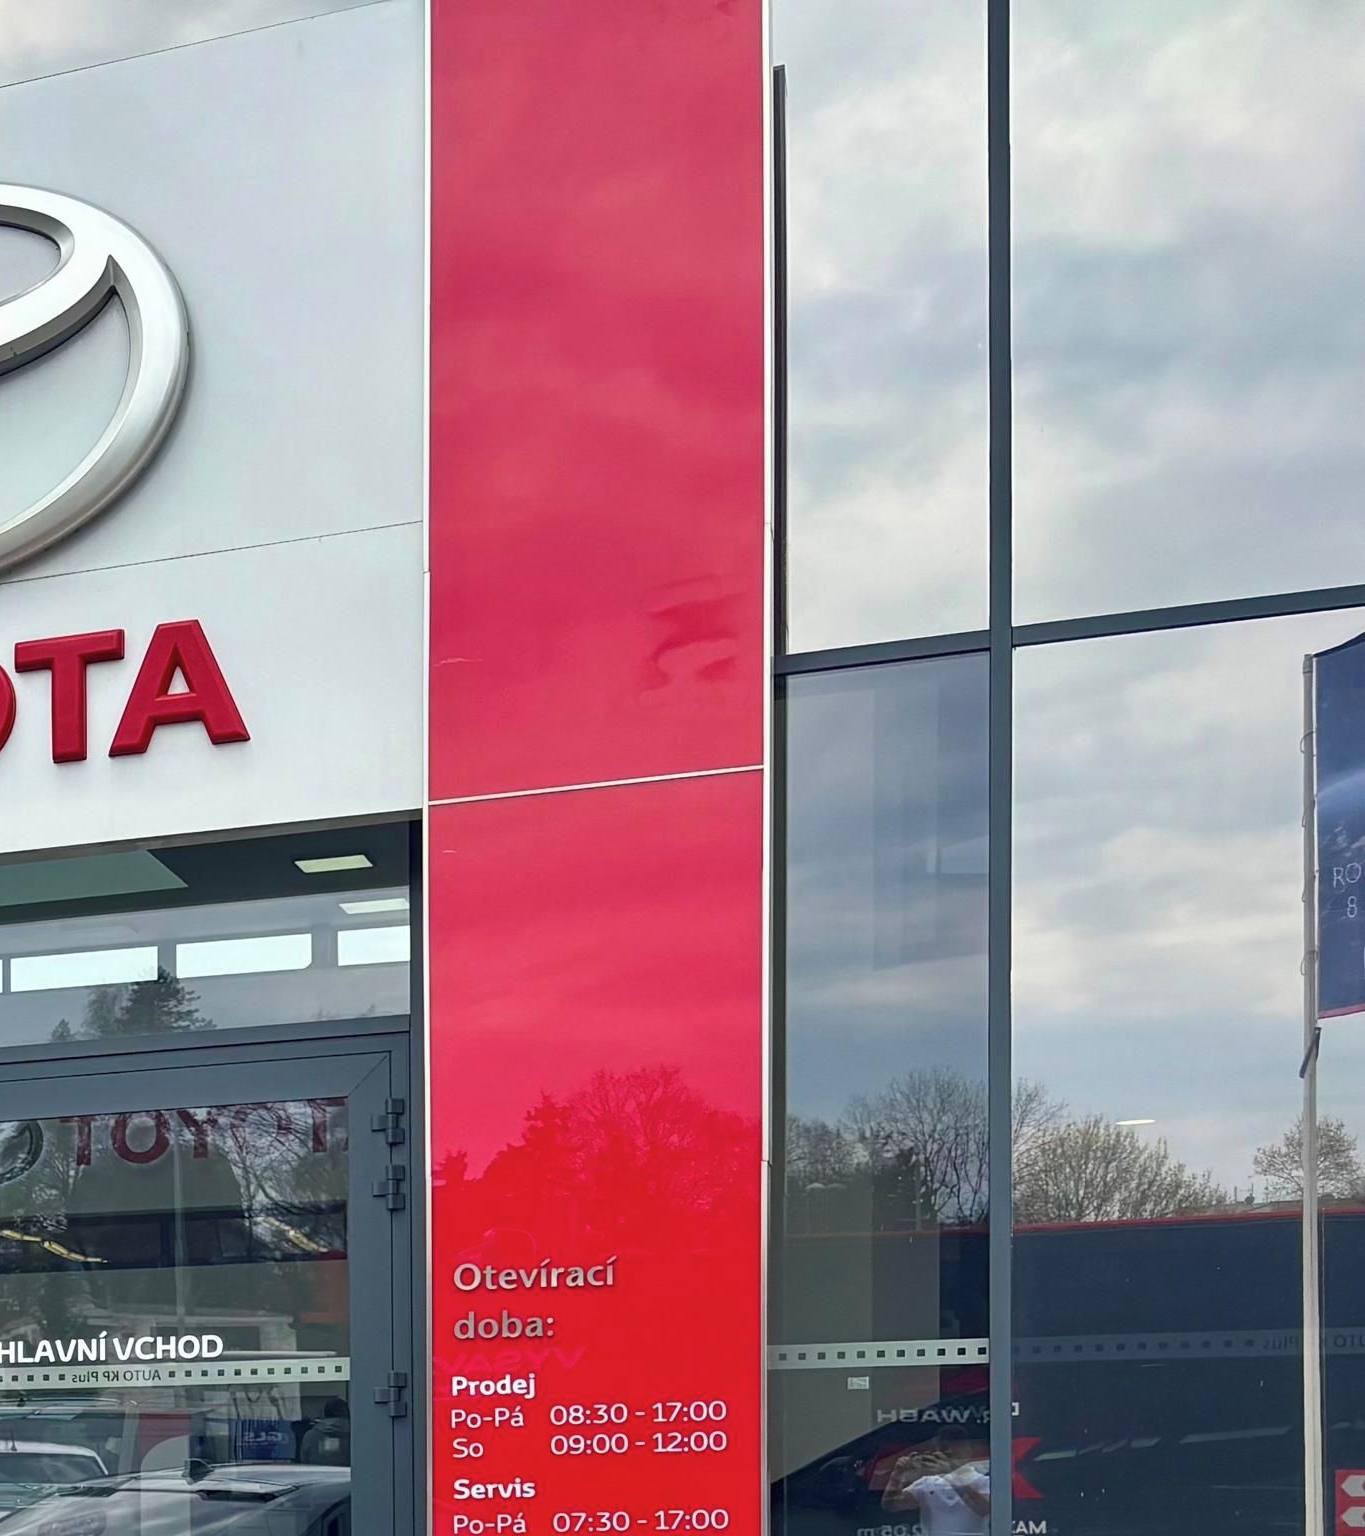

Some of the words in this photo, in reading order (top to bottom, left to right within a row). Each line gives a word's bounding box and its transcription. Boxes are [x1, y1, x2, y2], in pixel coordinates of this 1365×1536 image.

[453, 1256, 617, 1291] Otevírací
[453, 1309, 555, 1339] doba:
[112, 1334, 224, 1362] VCHOD
[451, 1373, 535, 1399] Prodej
[450, 1406, 525, 1429] Po-Pá
[549, 1403, 628, 1425] 08:30
[652, 1400, 727, 1423] 17:00
[452, 1438, 484, 1459] So
[550, 1433, 629, 1455] 09:00
[652, 1431, 727, 1453] 12:00
[453, 1477, 536, 1500] Servis
[453, 1512, 527, 1535] Po-Pá
[552, 1511, 630, 1533] 07:30
[654, 1509, 729, 1531] 17:00
